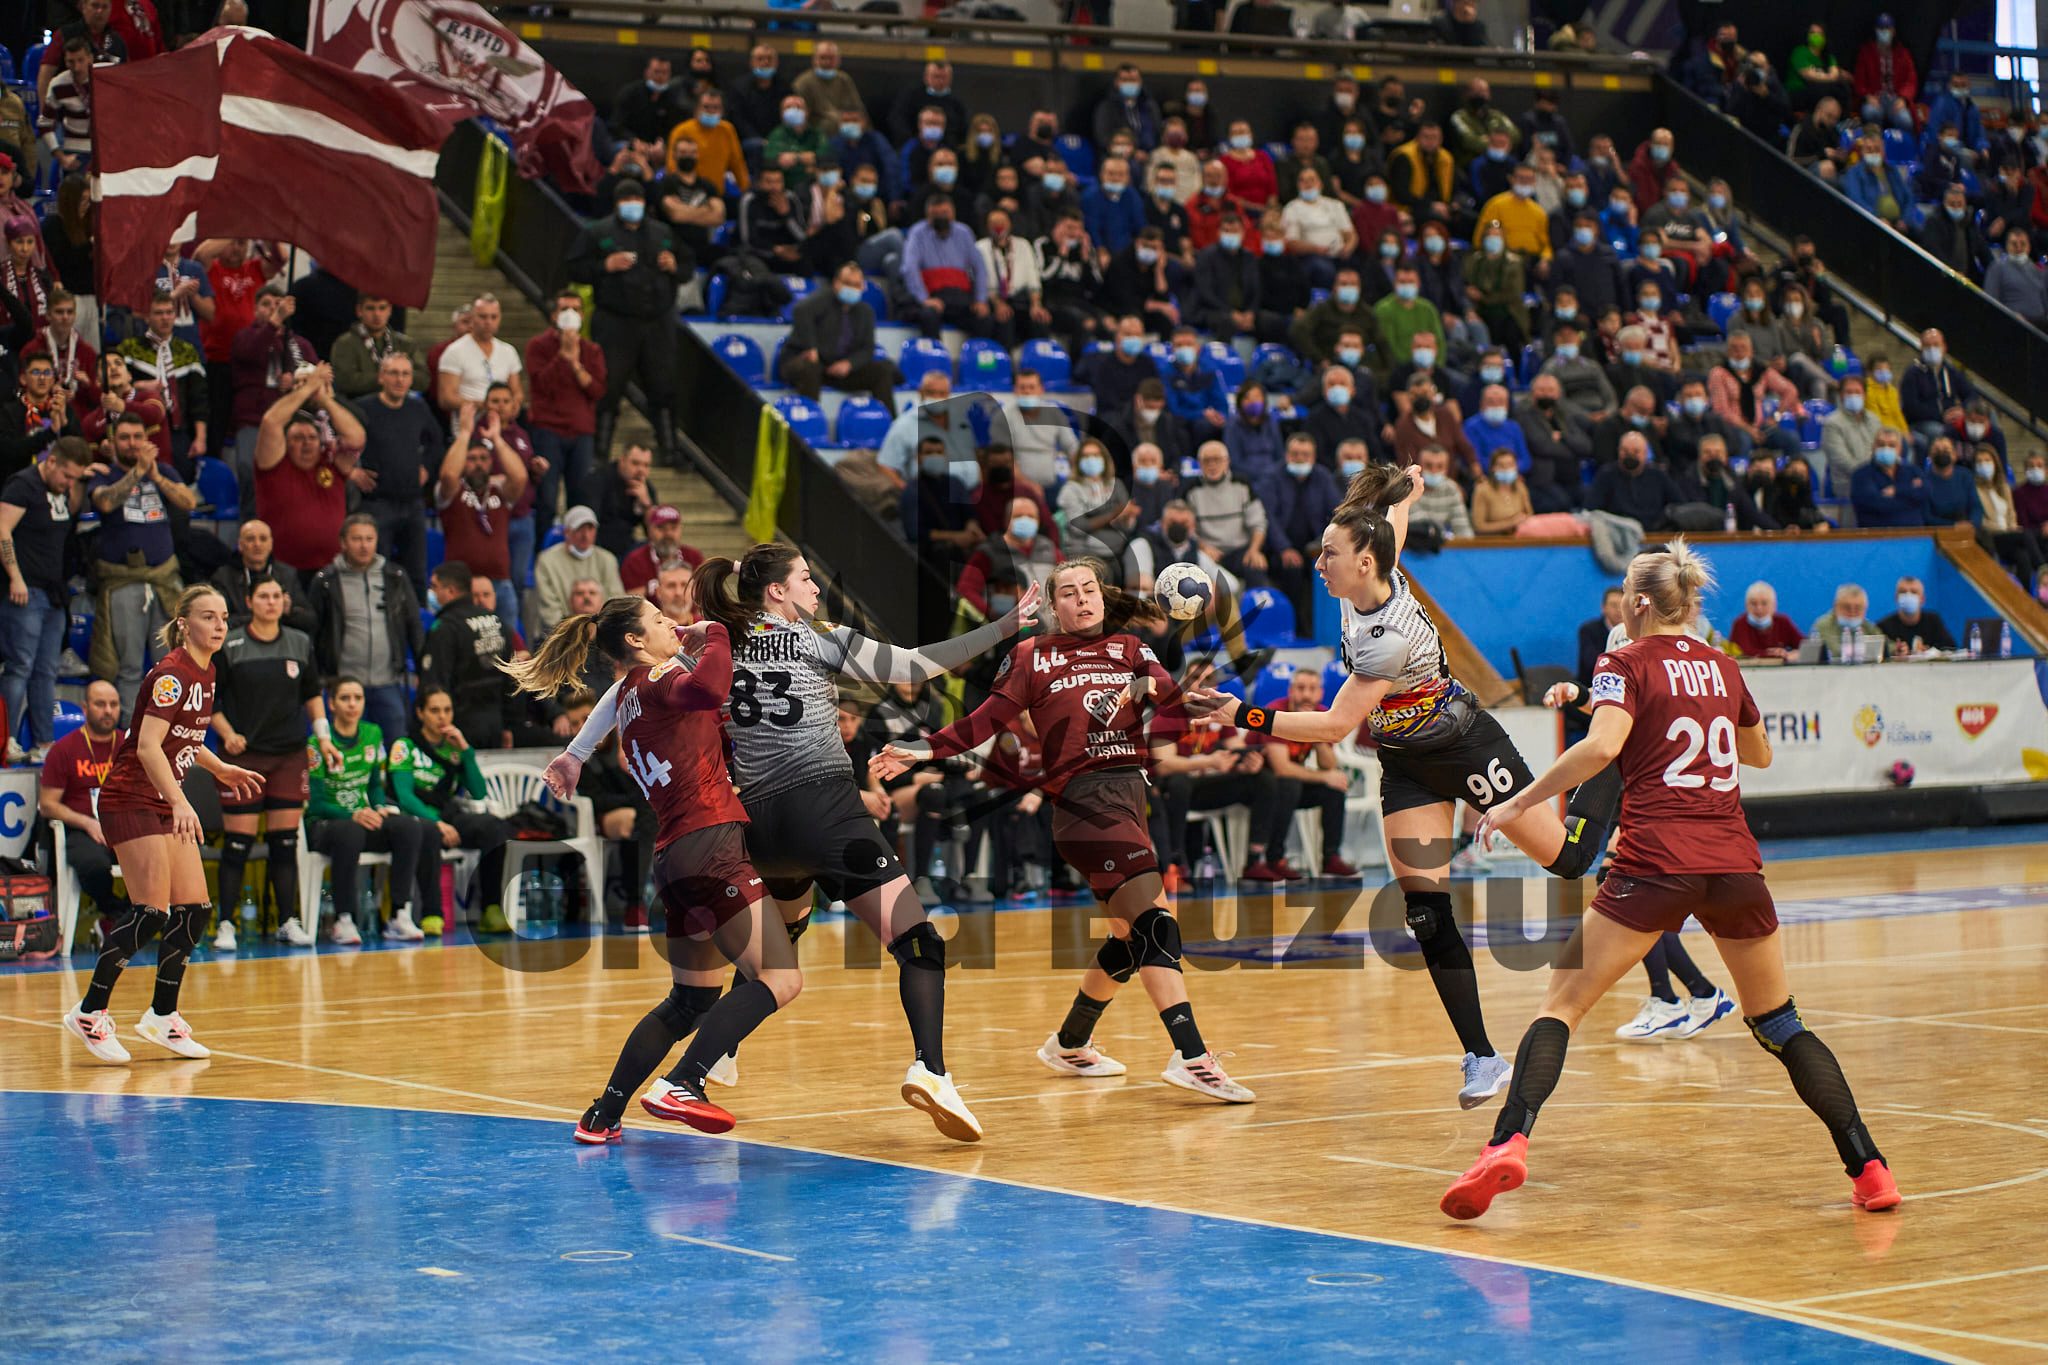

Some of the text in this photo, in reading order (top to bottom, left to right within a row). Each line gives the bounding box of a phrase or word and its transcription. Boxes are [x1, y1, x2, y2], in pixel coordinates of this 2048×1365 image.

[446, 19, 505, 53] RAPID
[1033, 646, 1068, 674] 44
[1049, 672, 1136, 694] SUPERBE
[1663, 659, 1728, 698] POPA
[729, 669, 804, 727] 83
[1087, 730, 1128, 744] INIMI
[1763, 711, 1820, 742] FRH
[1662, 715, 1739, 792] 29
[1466, 757, 1514, 805] 96
